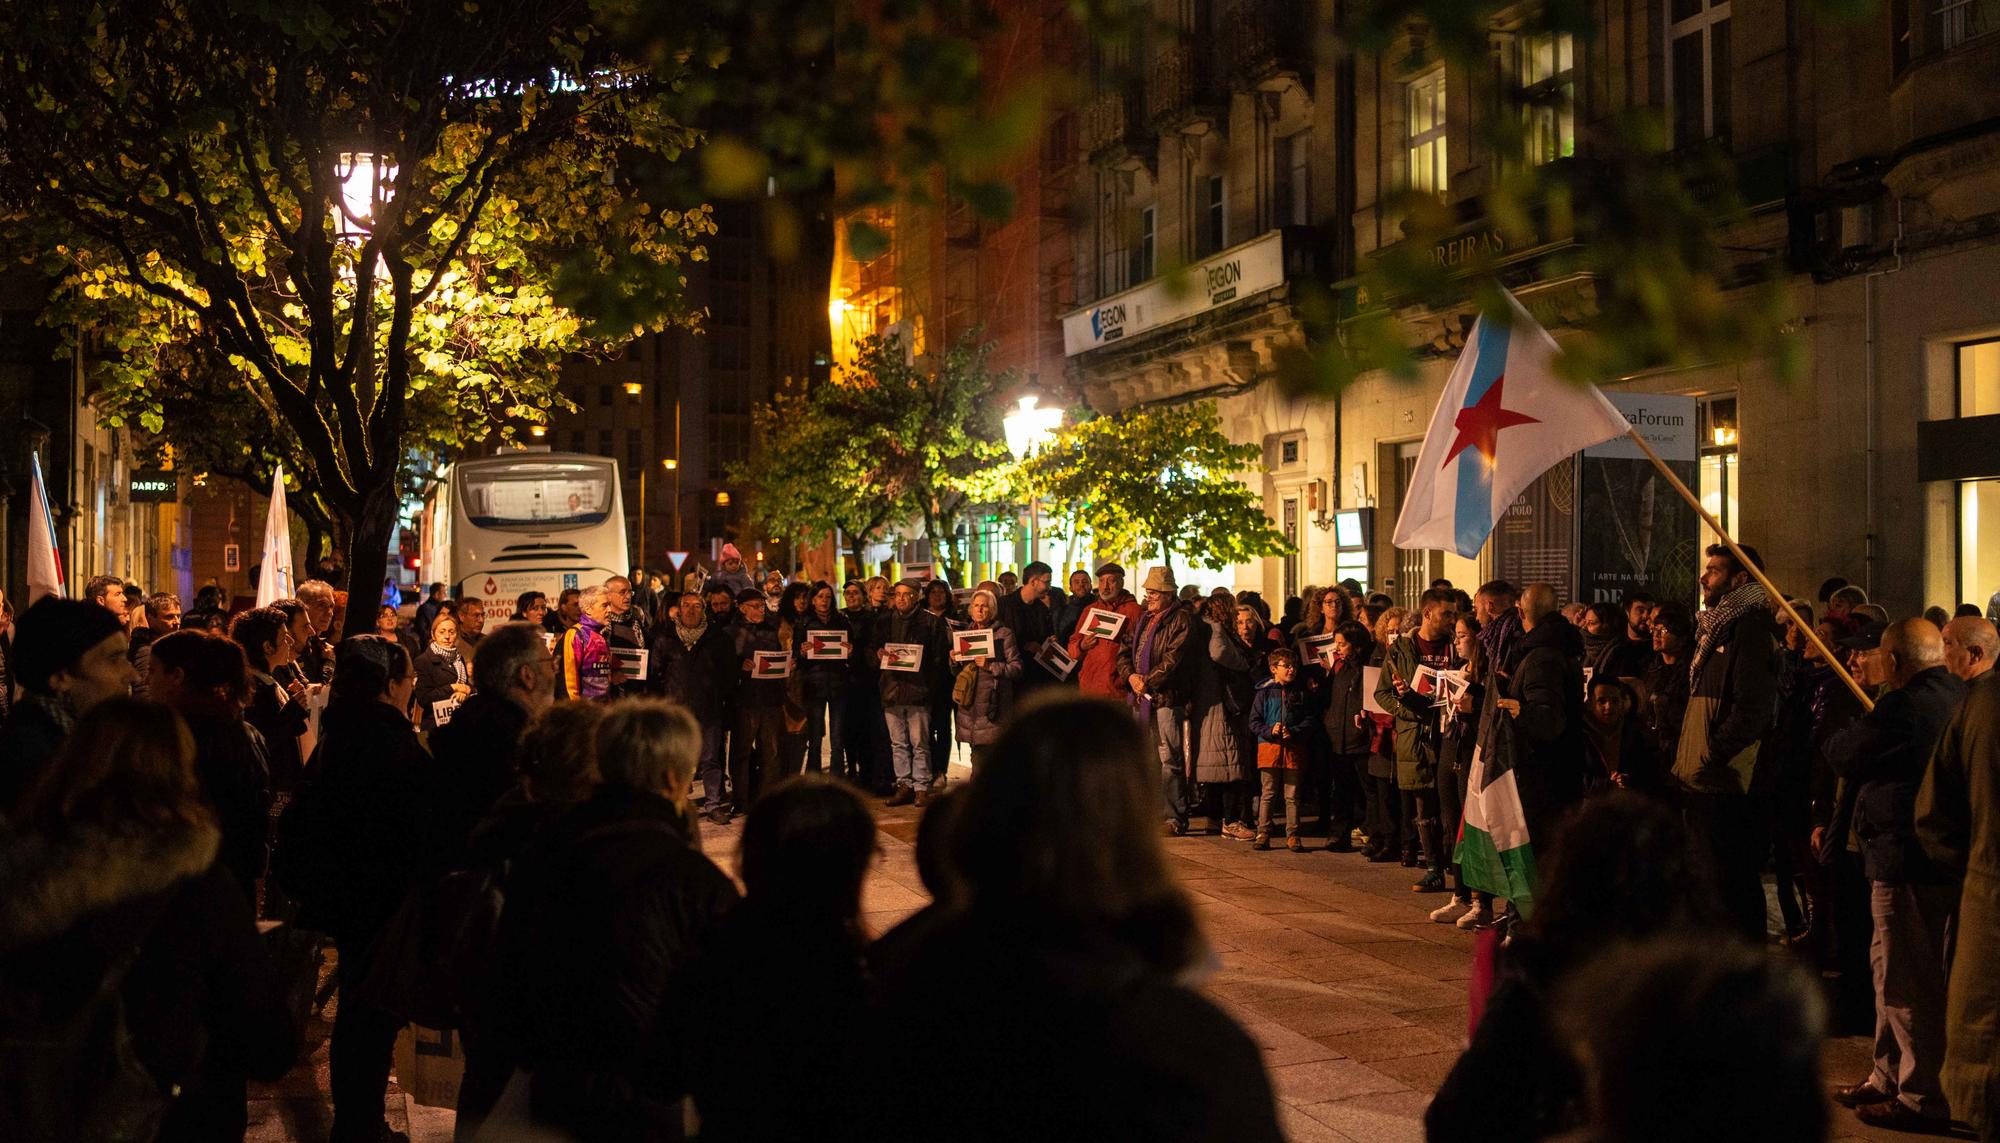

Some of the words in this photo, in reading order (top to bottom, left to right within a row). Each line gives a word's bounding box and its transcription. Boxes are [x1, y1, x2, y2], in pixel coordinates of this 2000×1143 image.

[131, 481, 176, 491] PARFO
[1512, 505, 1533, 516] POLO
[487, 607, 512, 618] 900
